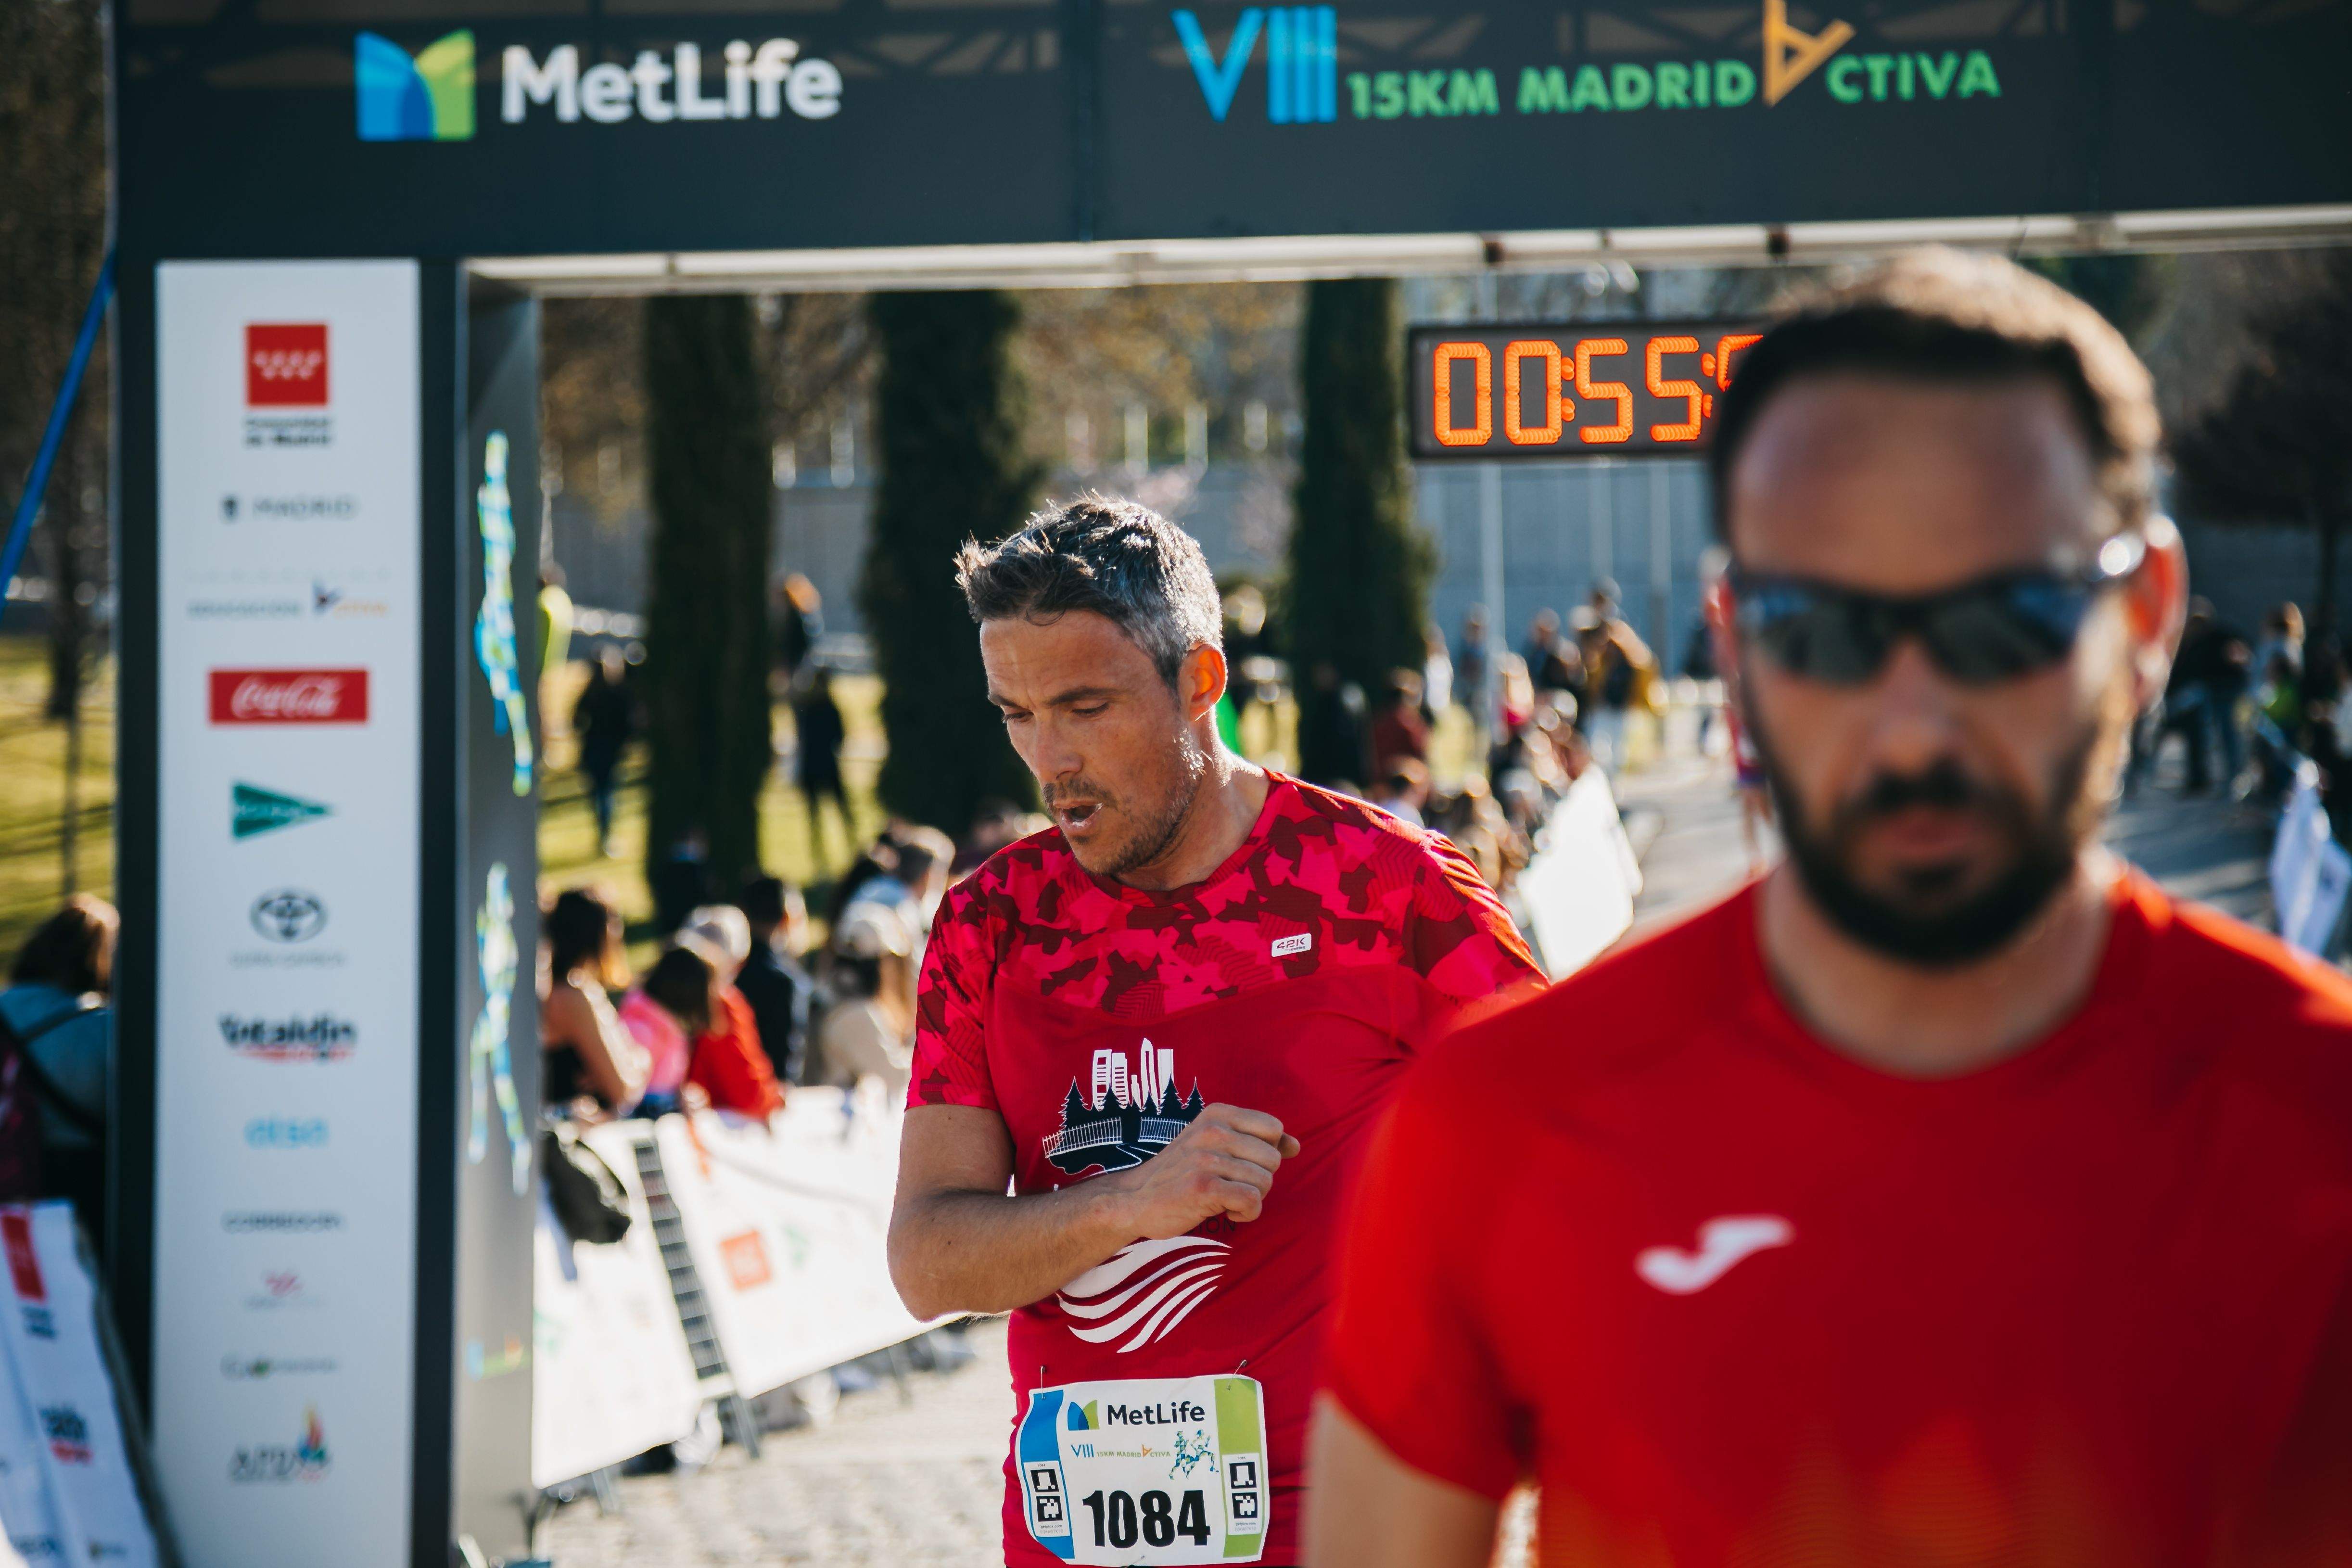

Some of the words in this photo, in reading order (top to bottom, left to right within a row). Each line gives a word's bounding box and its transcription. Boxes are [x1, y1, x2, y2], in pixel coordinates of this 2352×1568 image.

[501, 38, 843, 123] MetLife
[1170, 5, 1337, 124] VIII
[1348, 68, 1500, 119] 15KM
[1517, 60, 1757, 115] MADRID
[1106, 1401, 1205, 1426] MetLife
[1070, 1444, 1094, 1458] VIII
[1082, 1490, 1211, 1548] 1084
